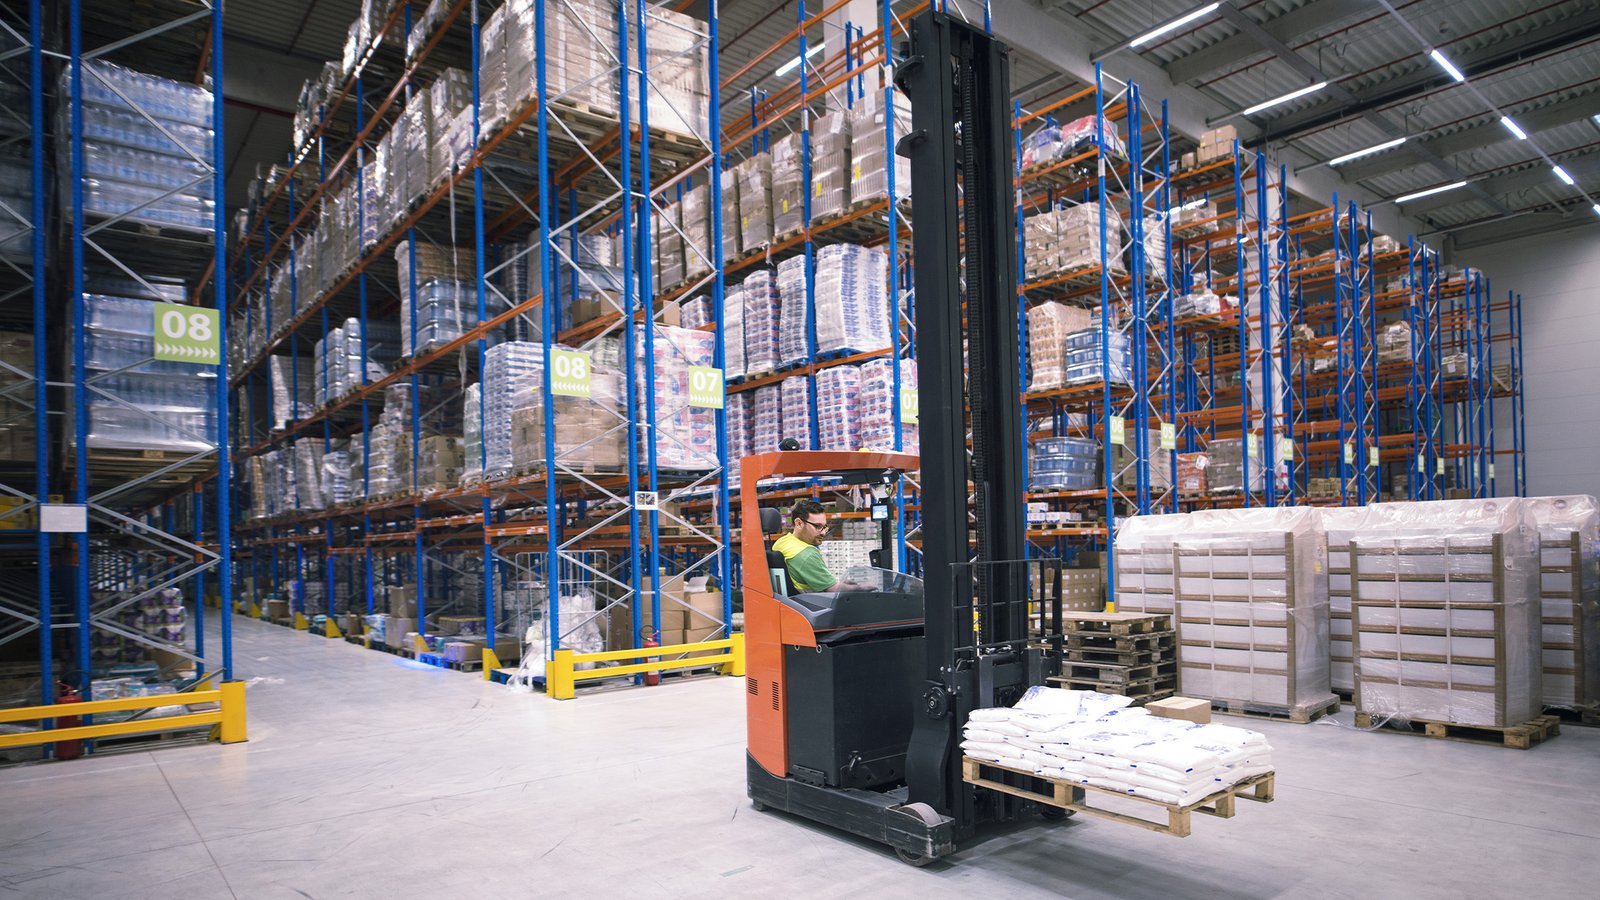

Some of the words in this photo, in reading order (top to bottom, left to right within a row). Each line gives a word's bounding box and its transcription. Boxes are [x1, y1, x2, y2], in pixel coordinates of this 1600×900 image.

[162, 310, 212, 341] 08
[555, 355, 586, 379] 08
[693, 371, 718, 392] 07
[903, 393, 918, 410] 07
[1111, 419, 1123, 433] 06
[1163, 425, 1173, 439] 05
